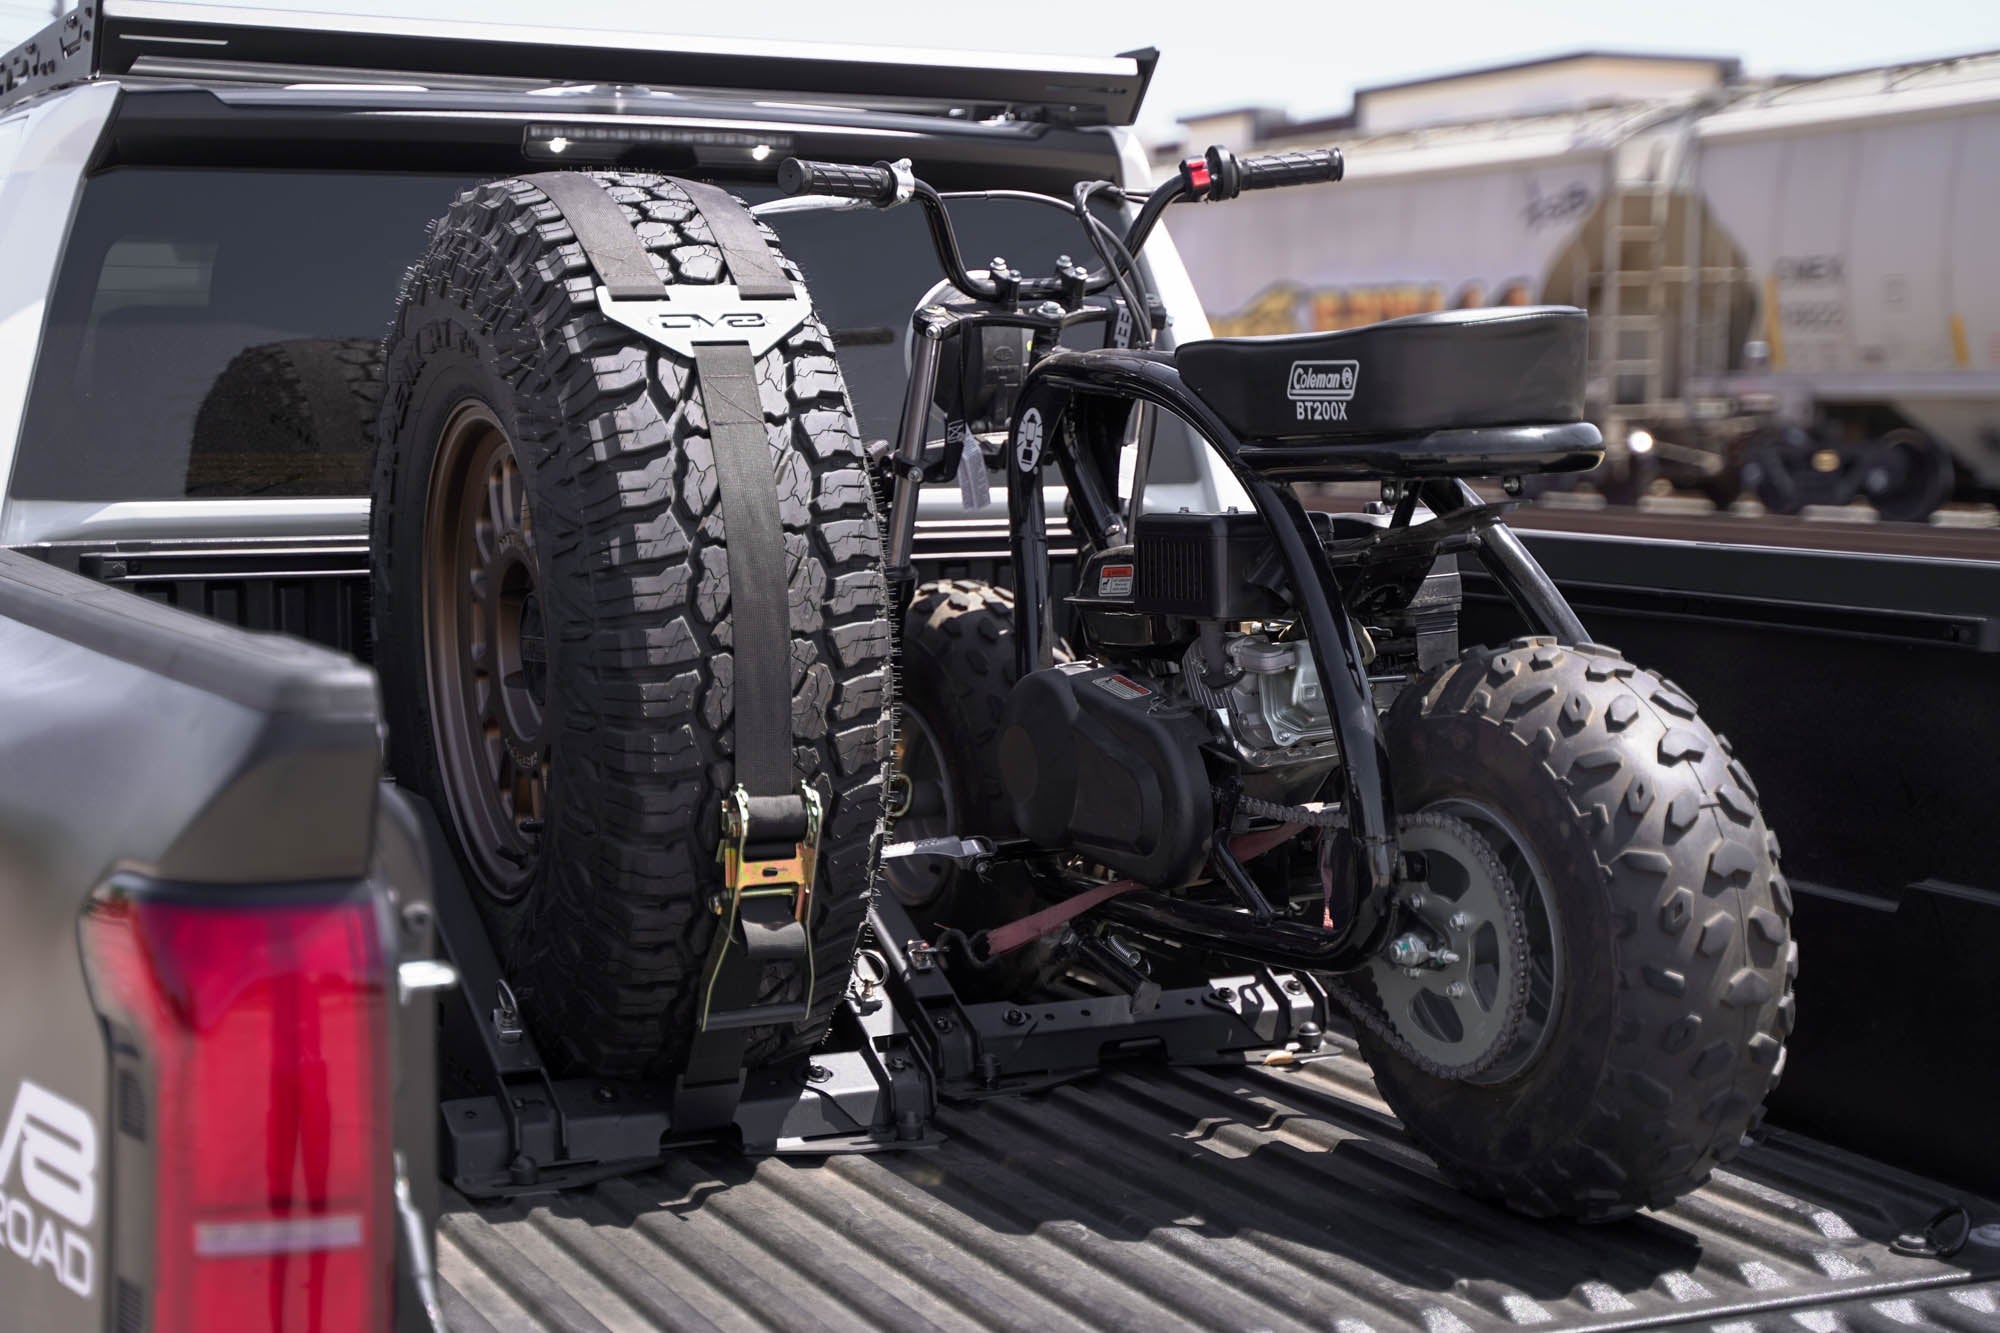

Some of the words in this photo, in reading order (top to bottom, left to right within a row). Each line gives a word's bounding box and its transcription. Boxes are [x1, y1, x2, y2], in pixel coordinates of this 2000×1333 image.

[1293, 367, 1341, 390] Coleman
[1296, 401, 1348, 420] BT200X
[0, 1190, 92, 1297] OAD
